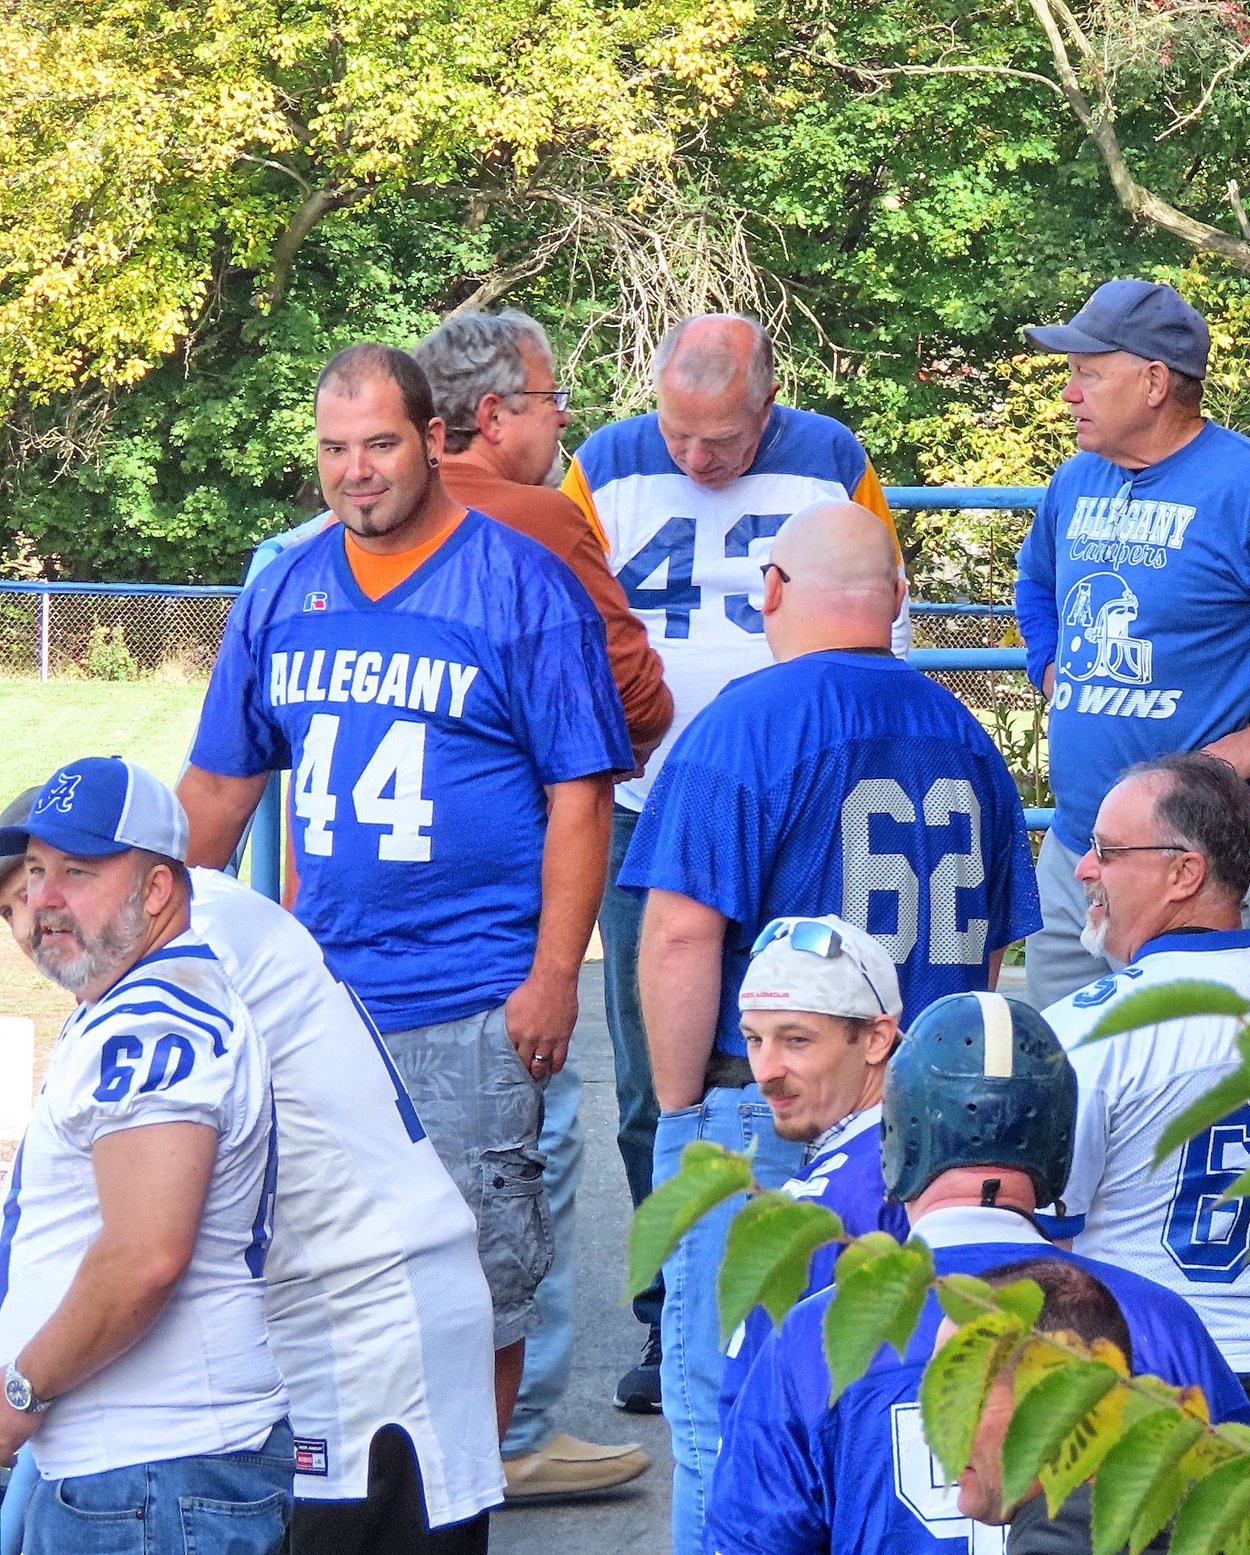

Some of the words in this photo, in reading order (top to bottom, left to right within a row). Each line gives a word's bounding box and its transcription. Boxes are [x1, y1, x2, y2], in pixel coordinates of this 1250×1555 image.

[1065, 496, 1197, 550] ALLEGANY
[1069, 533, 1168, 571] Campers
[270, 649, 480, 719] ALLEGANY
[1075, 685, 1184, 719] WINS
[294, 713, 434, 863] 44
[841, 778, 990, 965] 62
[92, 1032, 196, 1103] 60
